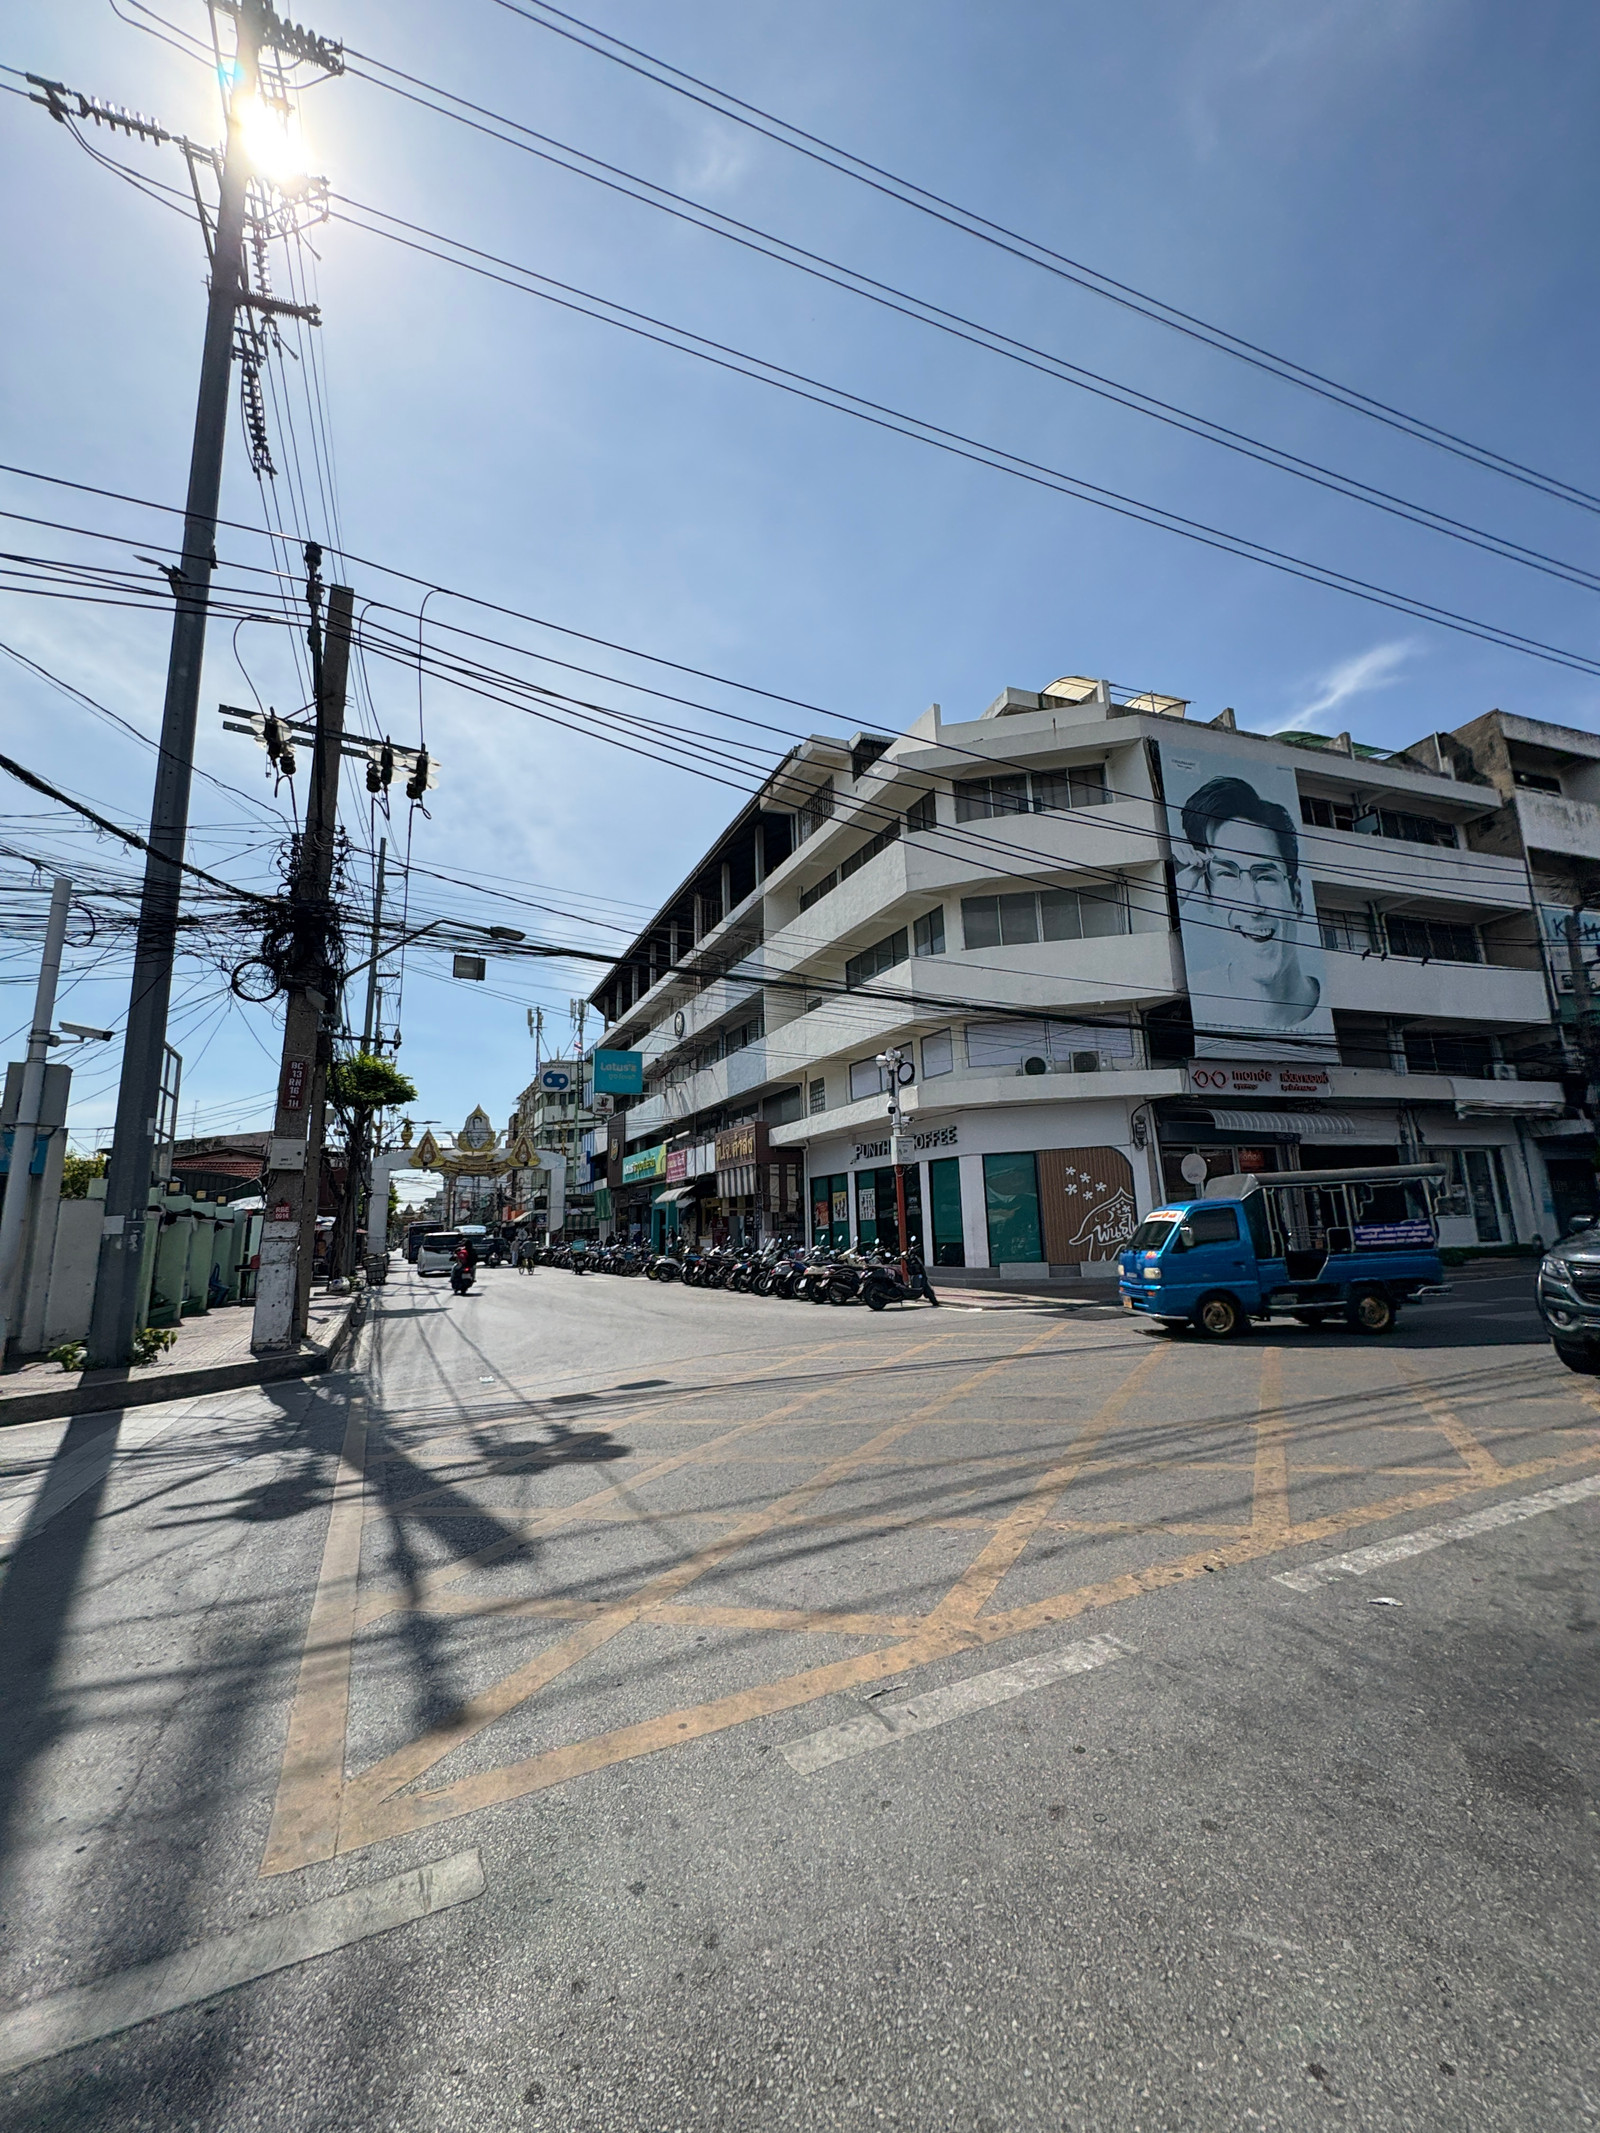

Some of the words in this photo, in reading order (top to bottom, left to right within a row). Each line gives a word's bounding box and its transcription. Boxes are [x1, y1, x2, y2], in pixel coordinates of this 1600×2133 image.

[291, 1062, 304, 1070] BC
[292, 1070, 303, 1078] 13
[288, 1078, 302, 1086] RN
[914, 1125, 958, 1151] OFFEE
